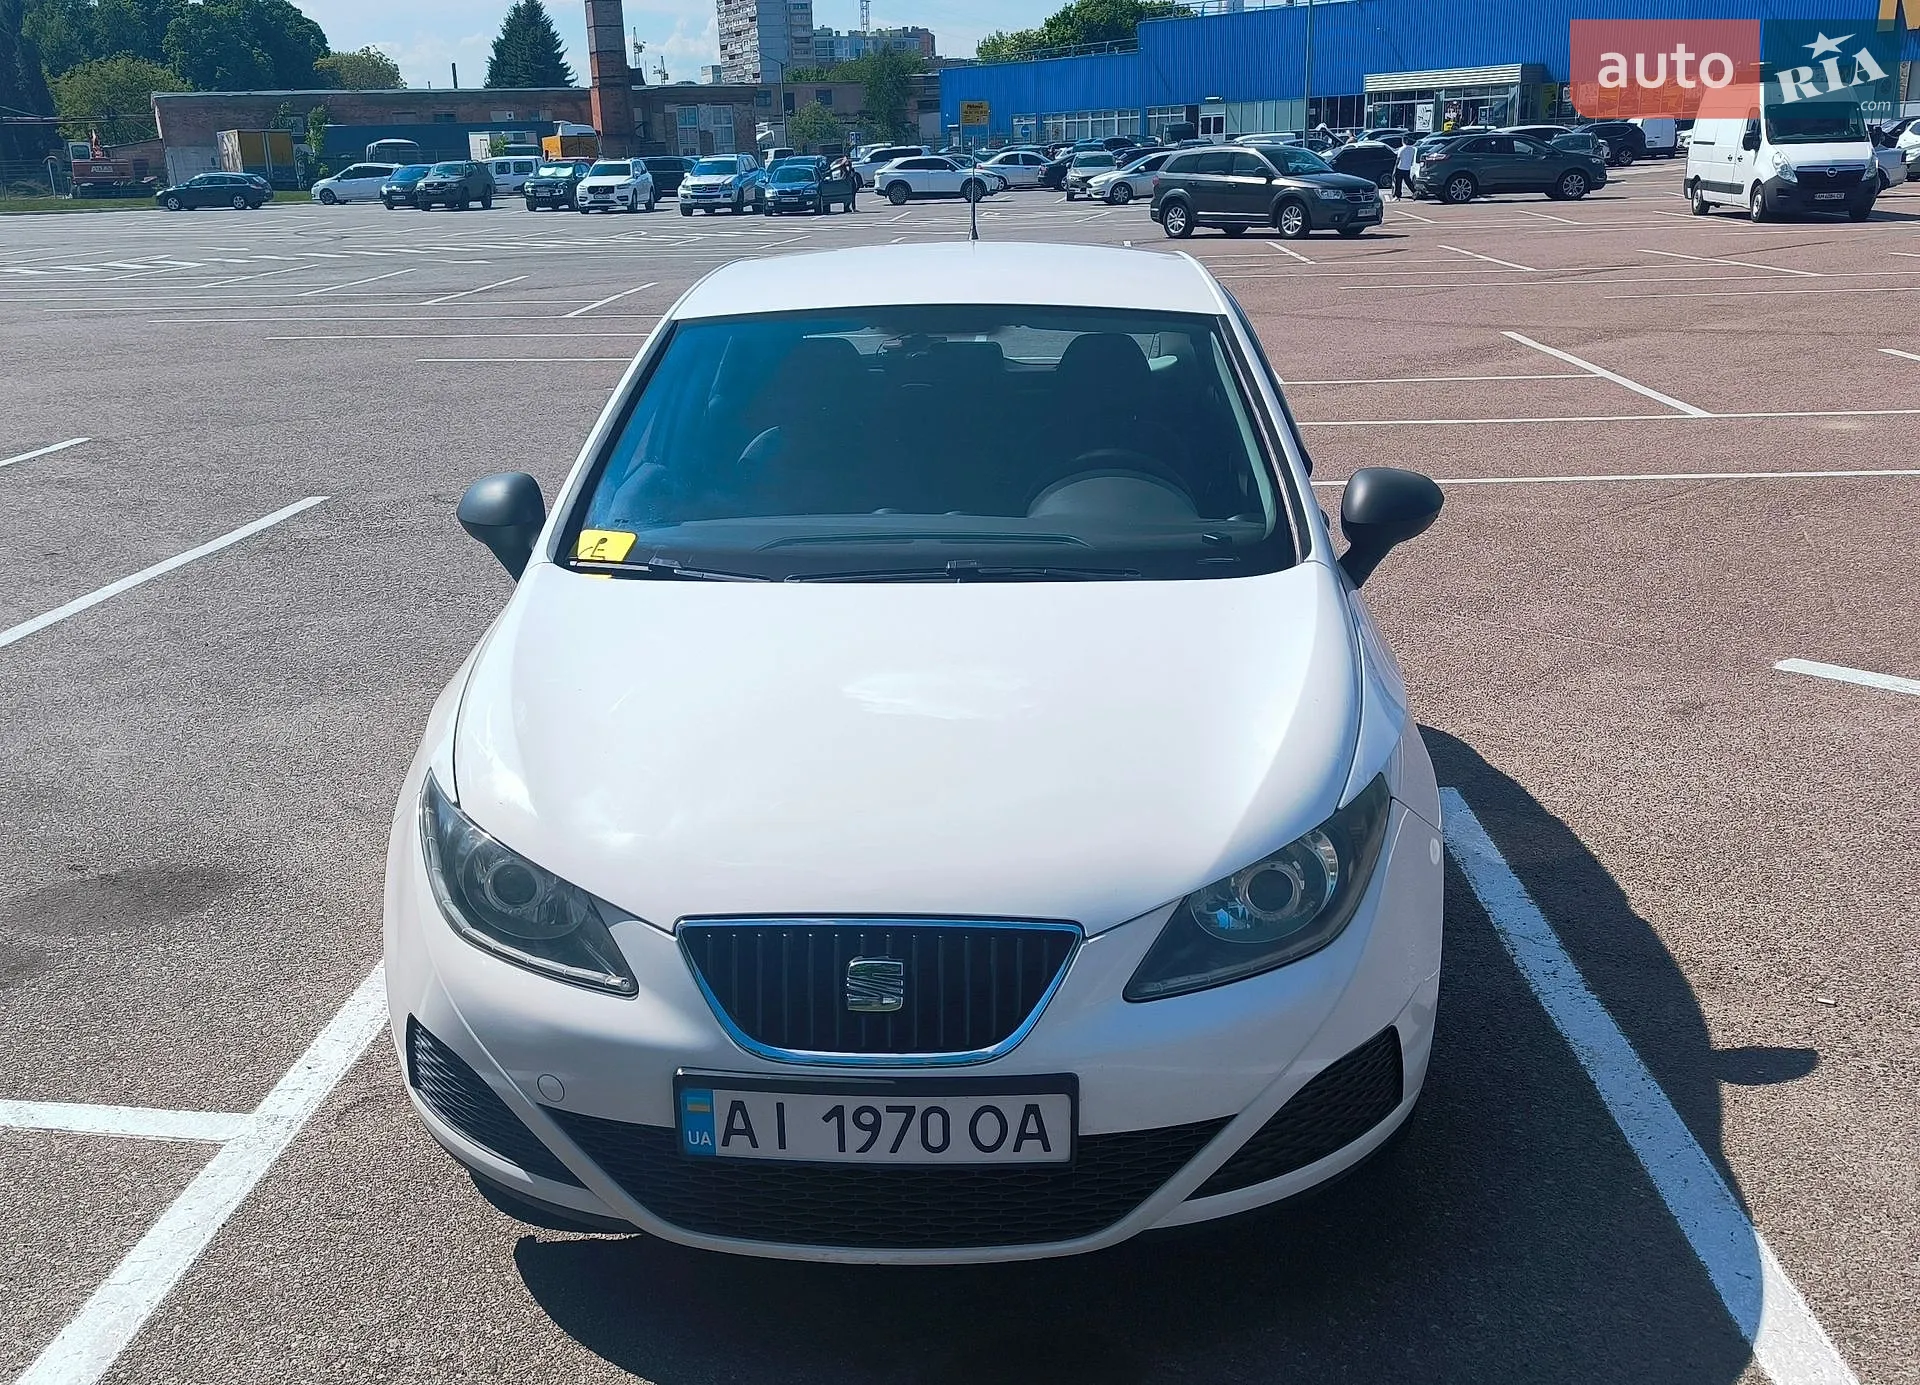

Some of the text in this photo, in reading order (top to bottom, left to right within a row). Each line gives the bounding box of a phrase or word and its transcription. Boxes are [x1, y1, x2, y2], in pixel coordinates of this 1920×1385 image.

[688, 1130, 712, 1146] UA
[721, 1100, 1052, 1154] AI 1970 OA
